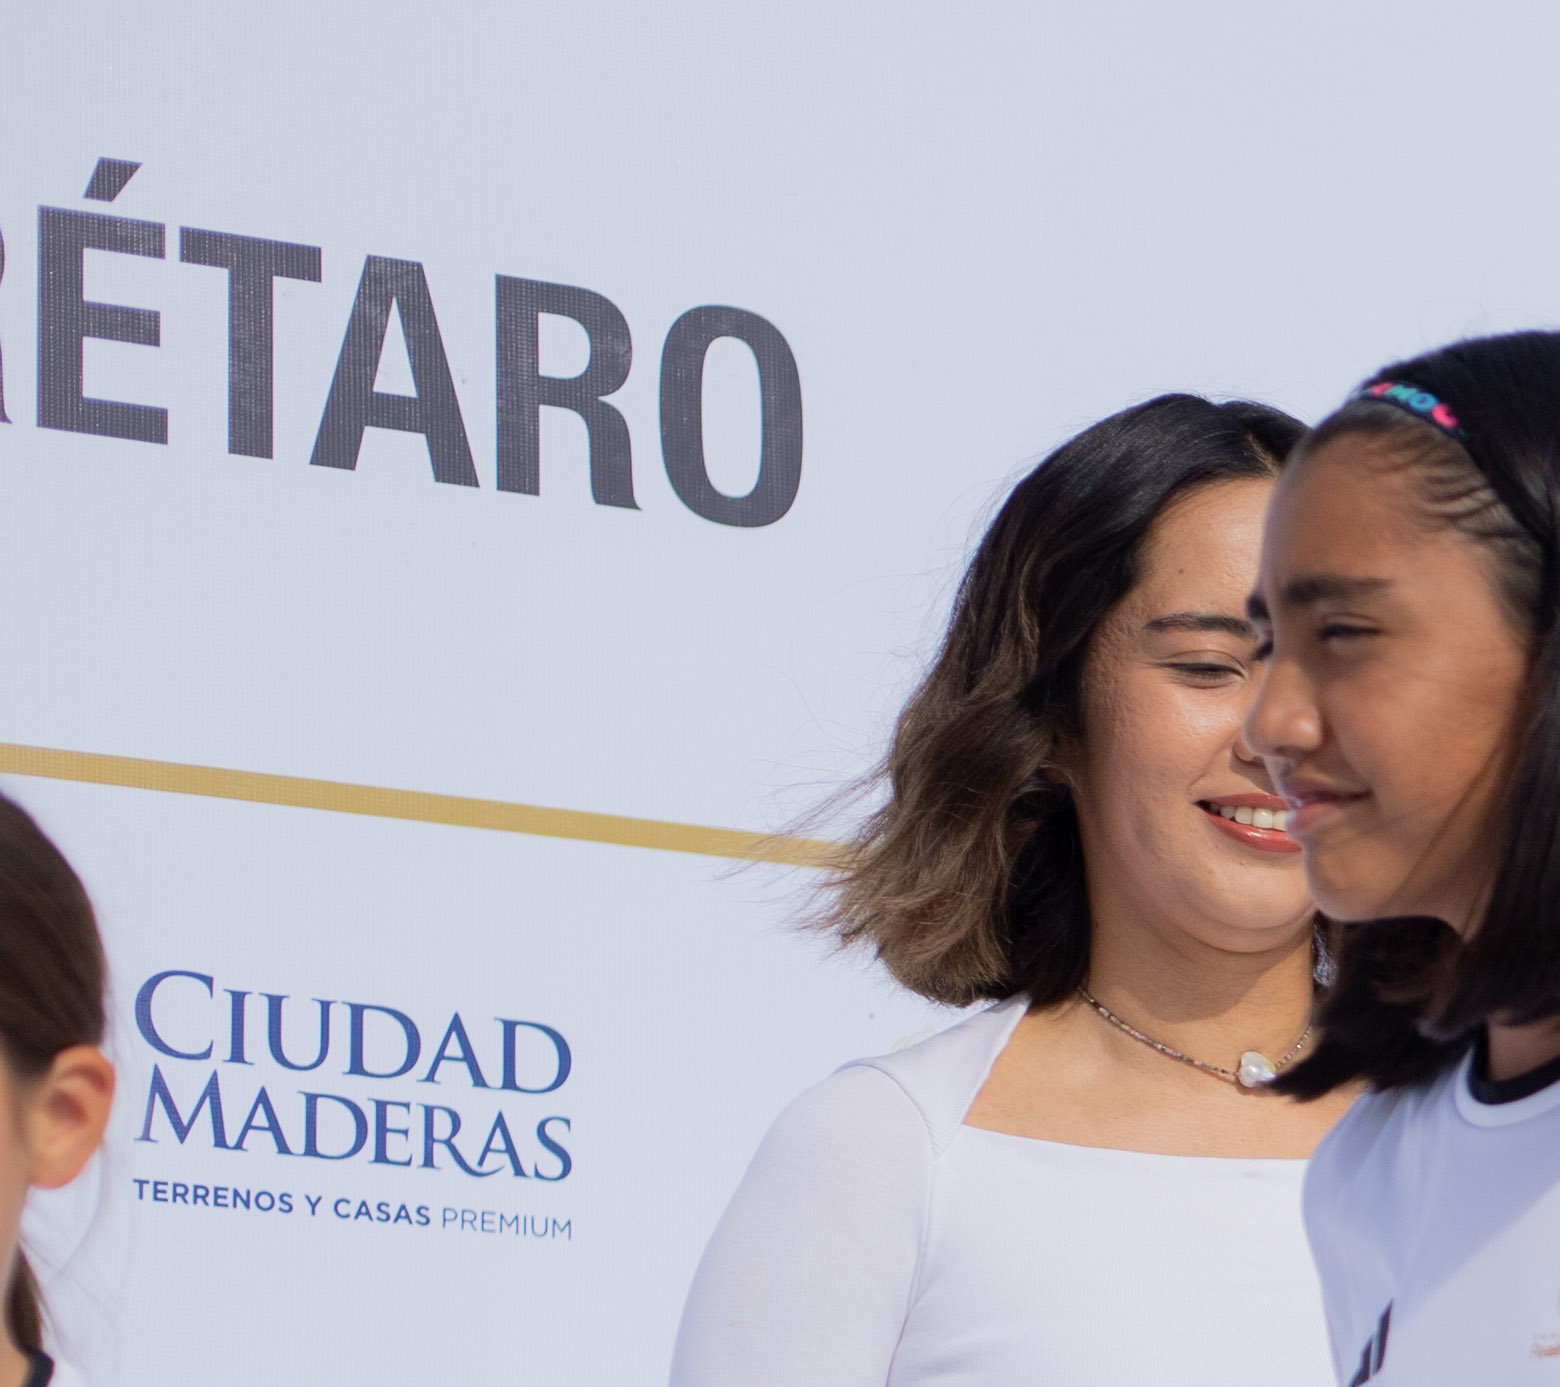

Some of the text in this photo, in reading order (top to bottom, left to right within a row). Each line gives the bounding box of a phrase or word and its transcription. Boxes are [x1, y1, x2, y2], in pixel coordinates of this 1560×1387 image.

[0, 157, 803, 529] ÉTARO
[135, 970, 572, 1094] CIUDAD
[135, 1067, 572, 1182] MADERAS
[133, 1178, 572, 1241] TERRENOS Y CASAS PREMIUM
